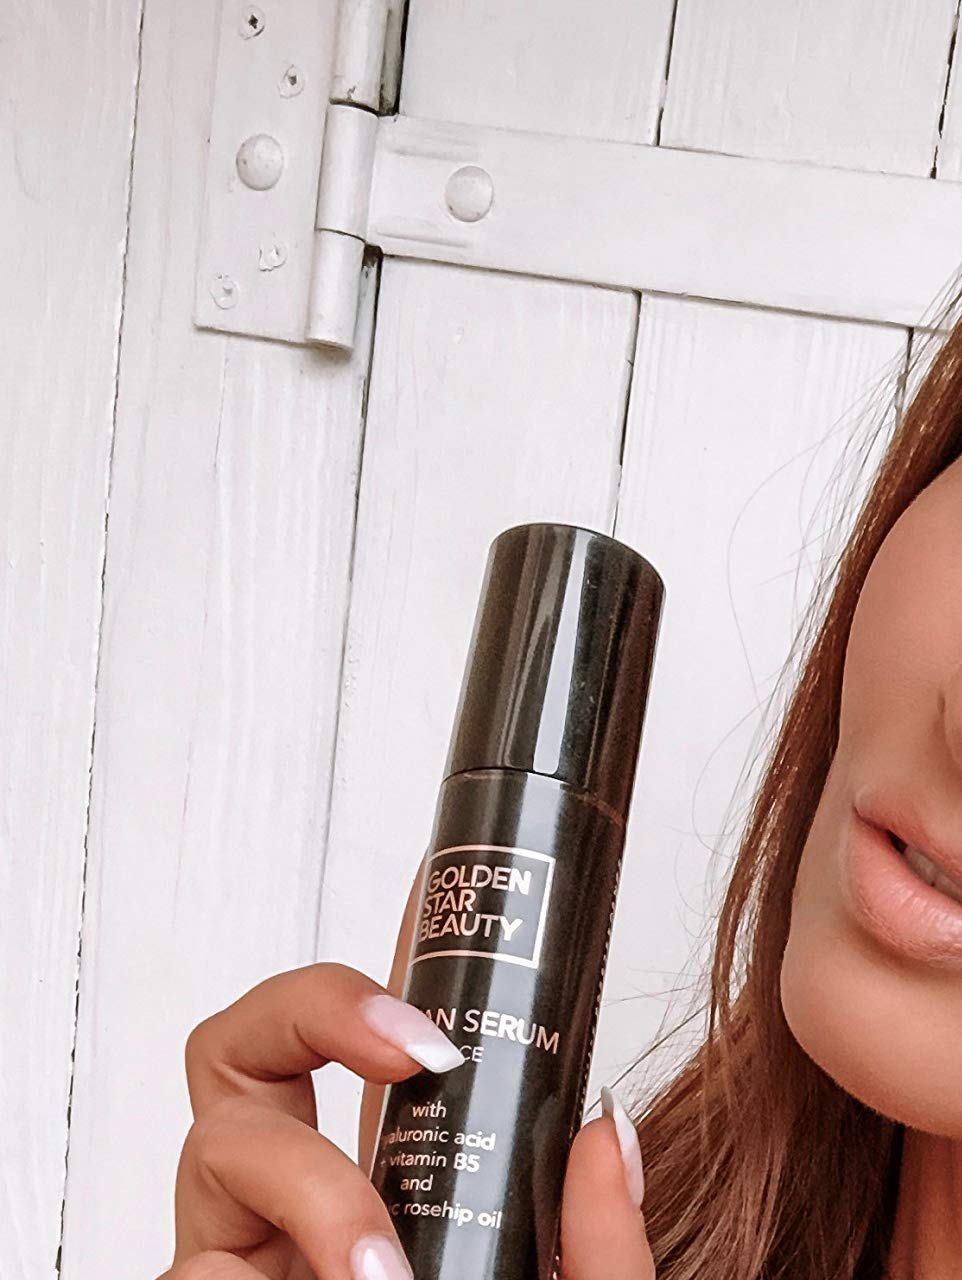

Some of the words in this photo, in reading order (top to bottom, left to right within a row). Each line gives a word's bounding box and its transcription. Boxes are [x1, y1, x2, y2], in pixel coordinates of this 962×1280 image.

[427, 864, 532, 896] GOLDEN
[422, 888, 477, 918] STAR
[419, 912, 524, 942] BEAUTY
[462, 1008, 560, 1054] SERUM
[412, 1100, 447, 1119] with
[453, 1130, 497, 1151] acid
[390, 1150, 447, 1168] vitamin
[453, 1152, 481, 1172] B5
[400, 1173, 434, 1191] and
[404, 1200, 474, 1227] rosehip
[477, 1210, 503, 1229] oil
